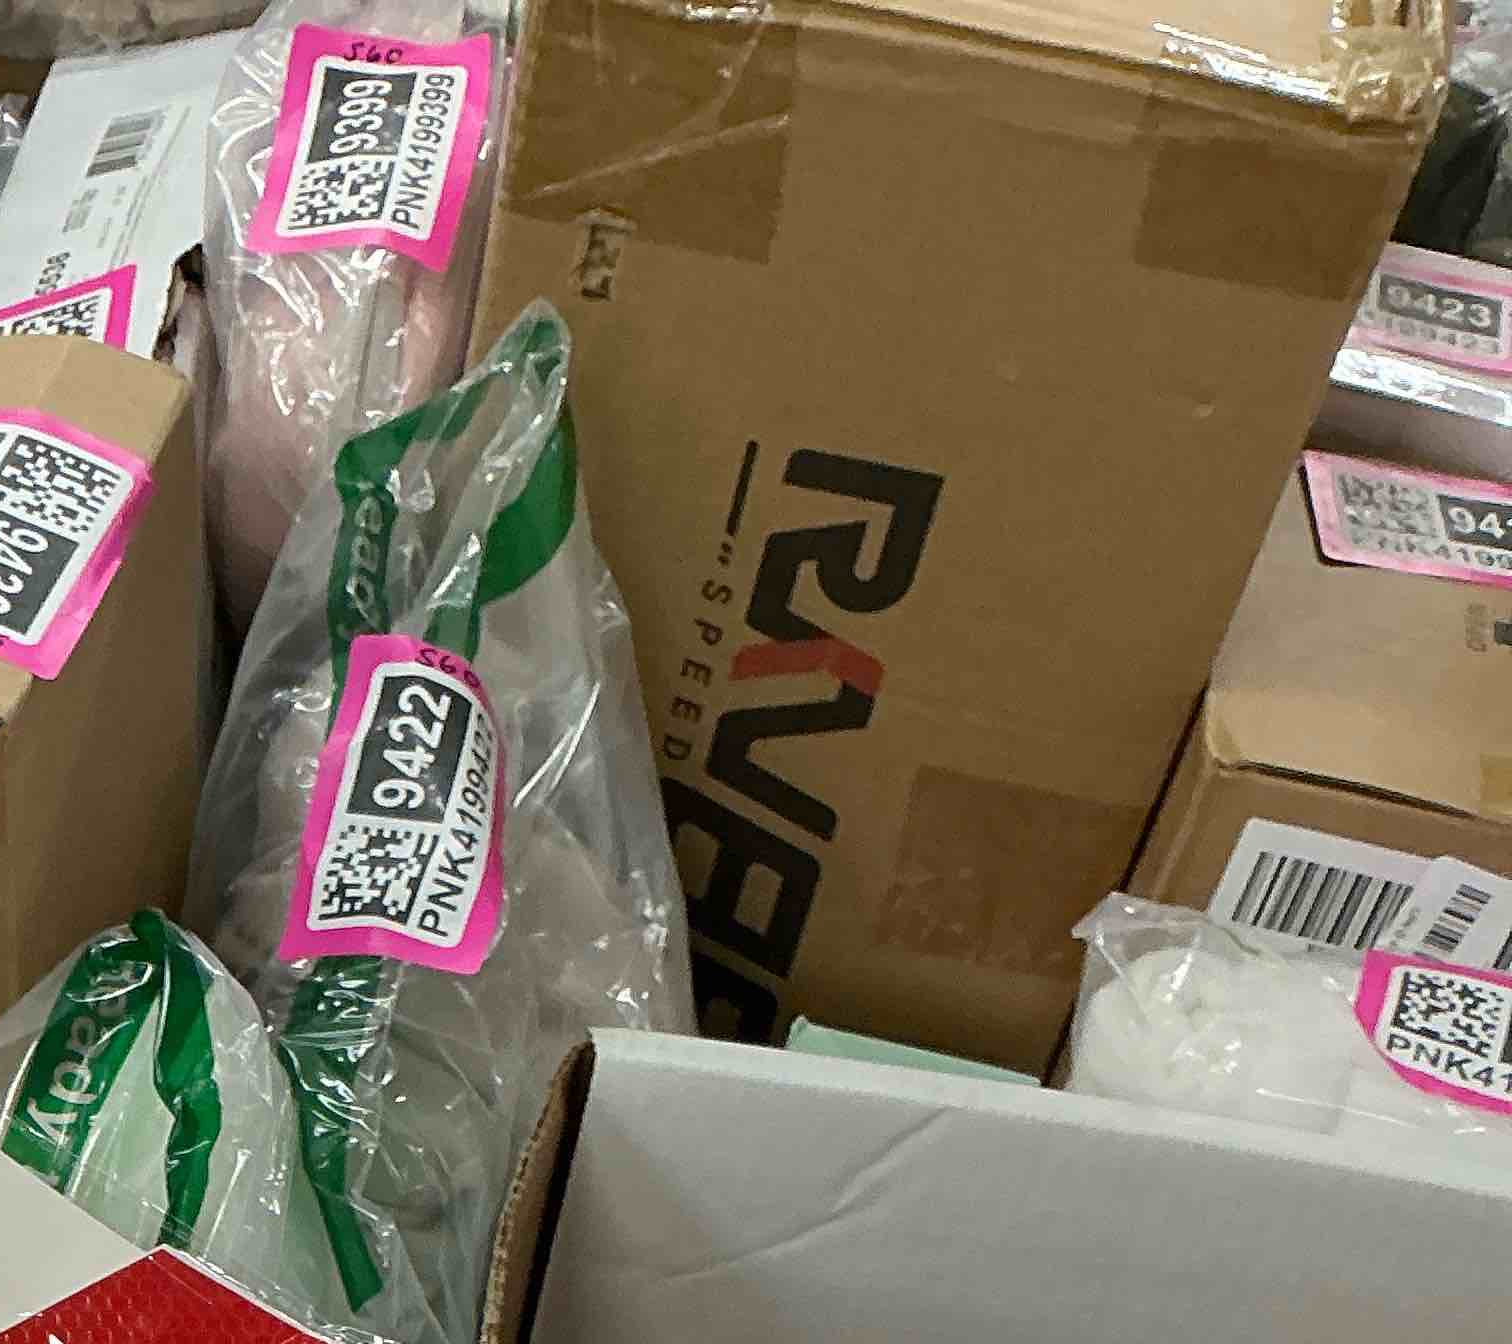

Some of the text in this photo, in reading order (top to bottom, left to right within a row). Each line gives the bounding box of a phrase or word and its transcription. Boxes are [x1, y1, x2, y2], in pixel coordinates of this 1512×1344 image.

[343, 41, 403, 64] 560
[328, 79, 393, 154] 9399
[390, 73, 455, 230] PNK4199399
[372, 684, 454, 810] 9422
